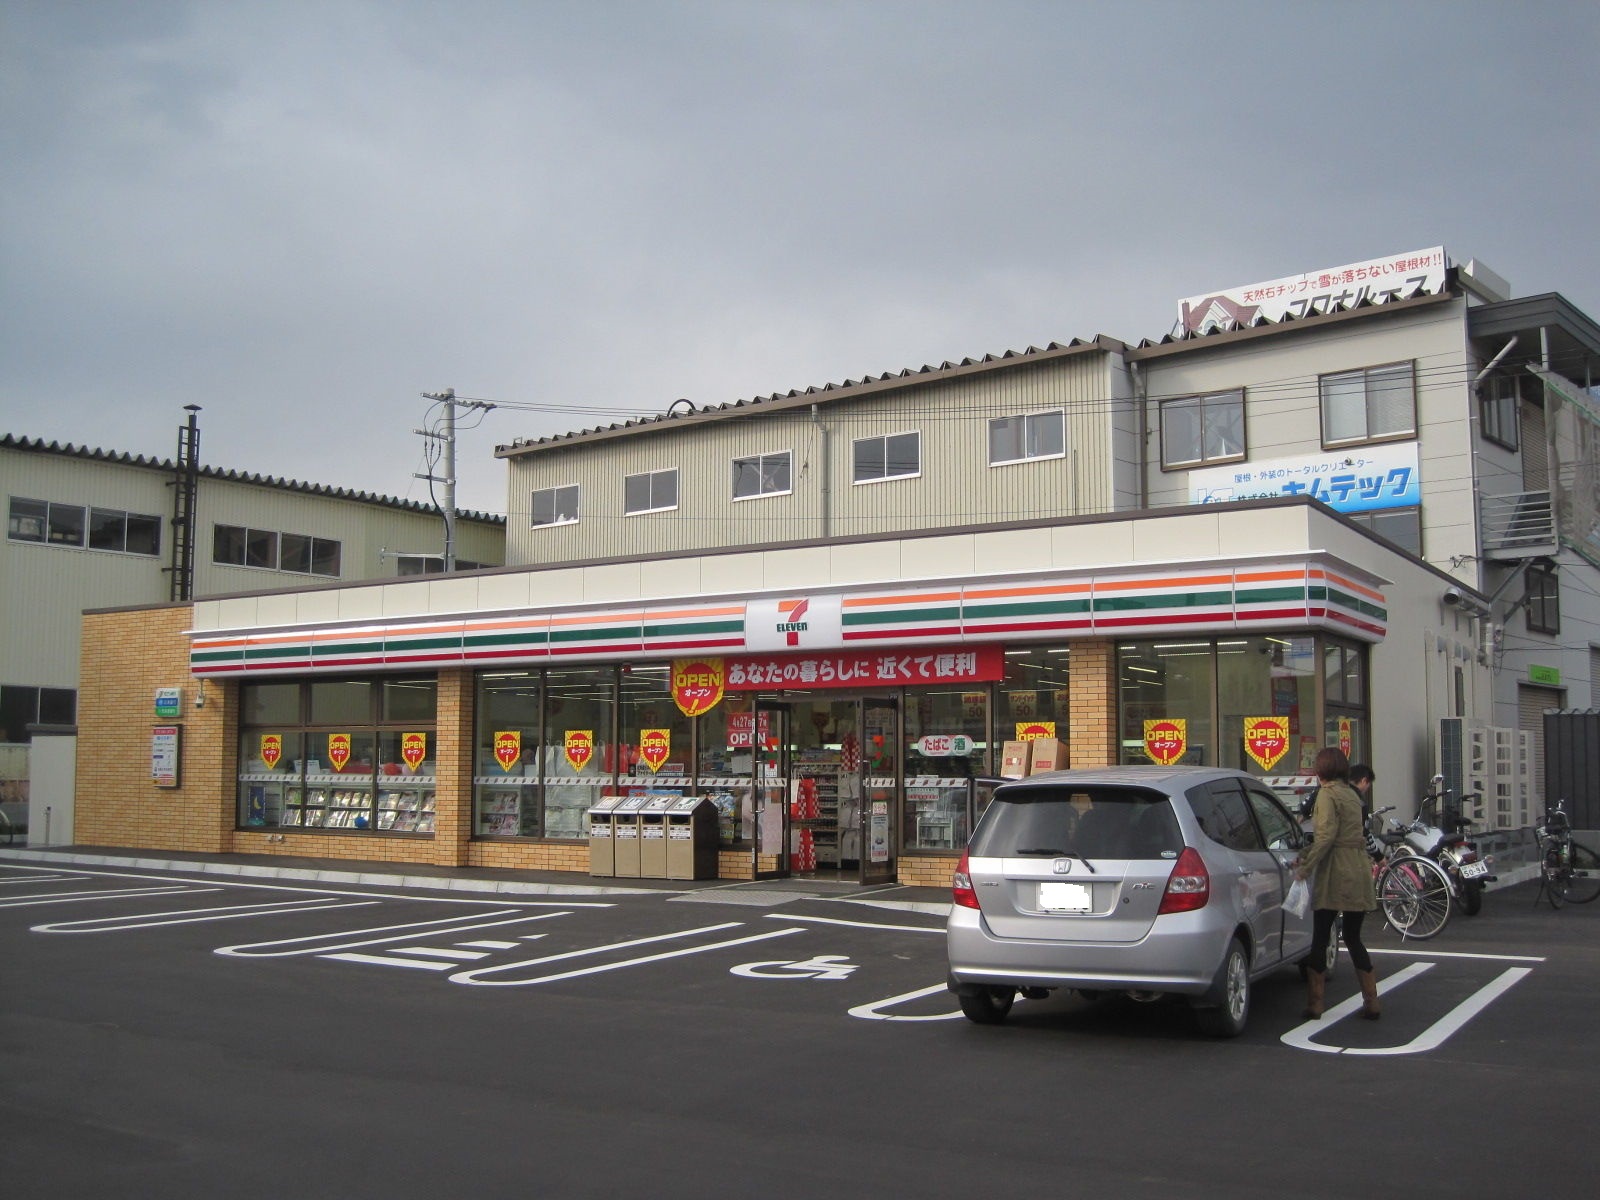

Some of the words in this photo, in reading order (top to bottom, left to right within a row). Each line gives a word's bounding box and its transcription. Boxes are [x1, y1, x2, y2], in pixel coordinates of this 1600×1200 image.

[778, 599, 809, 645] 7
[728, 659, 870, 685] あなたの暮らしに
[876, 652, 977, 679] 近くて便利
[676, 673, 721, 687] OPEN
[685, 688, 711, 697] オープン
[1146, 730, 1185, 741] OPEN
[1247, 728, 1288, 739] OPEN
[262, 742, 281, 750] OPEN
[330, 742, 349, 750] OPEN
[403, 741, 424, 749] OPEN
[496, 739, 520, 748] OPEN
[566, 739, 592, 748] OPEN
[642, 738, 668, 748] OPEN
[924, 737, 950, 751] たばこ
[953, 737, 966, 751] 酒
[1154, 741, 1176, 749] オープン
[1255, 740, 1279, 748] オープン
